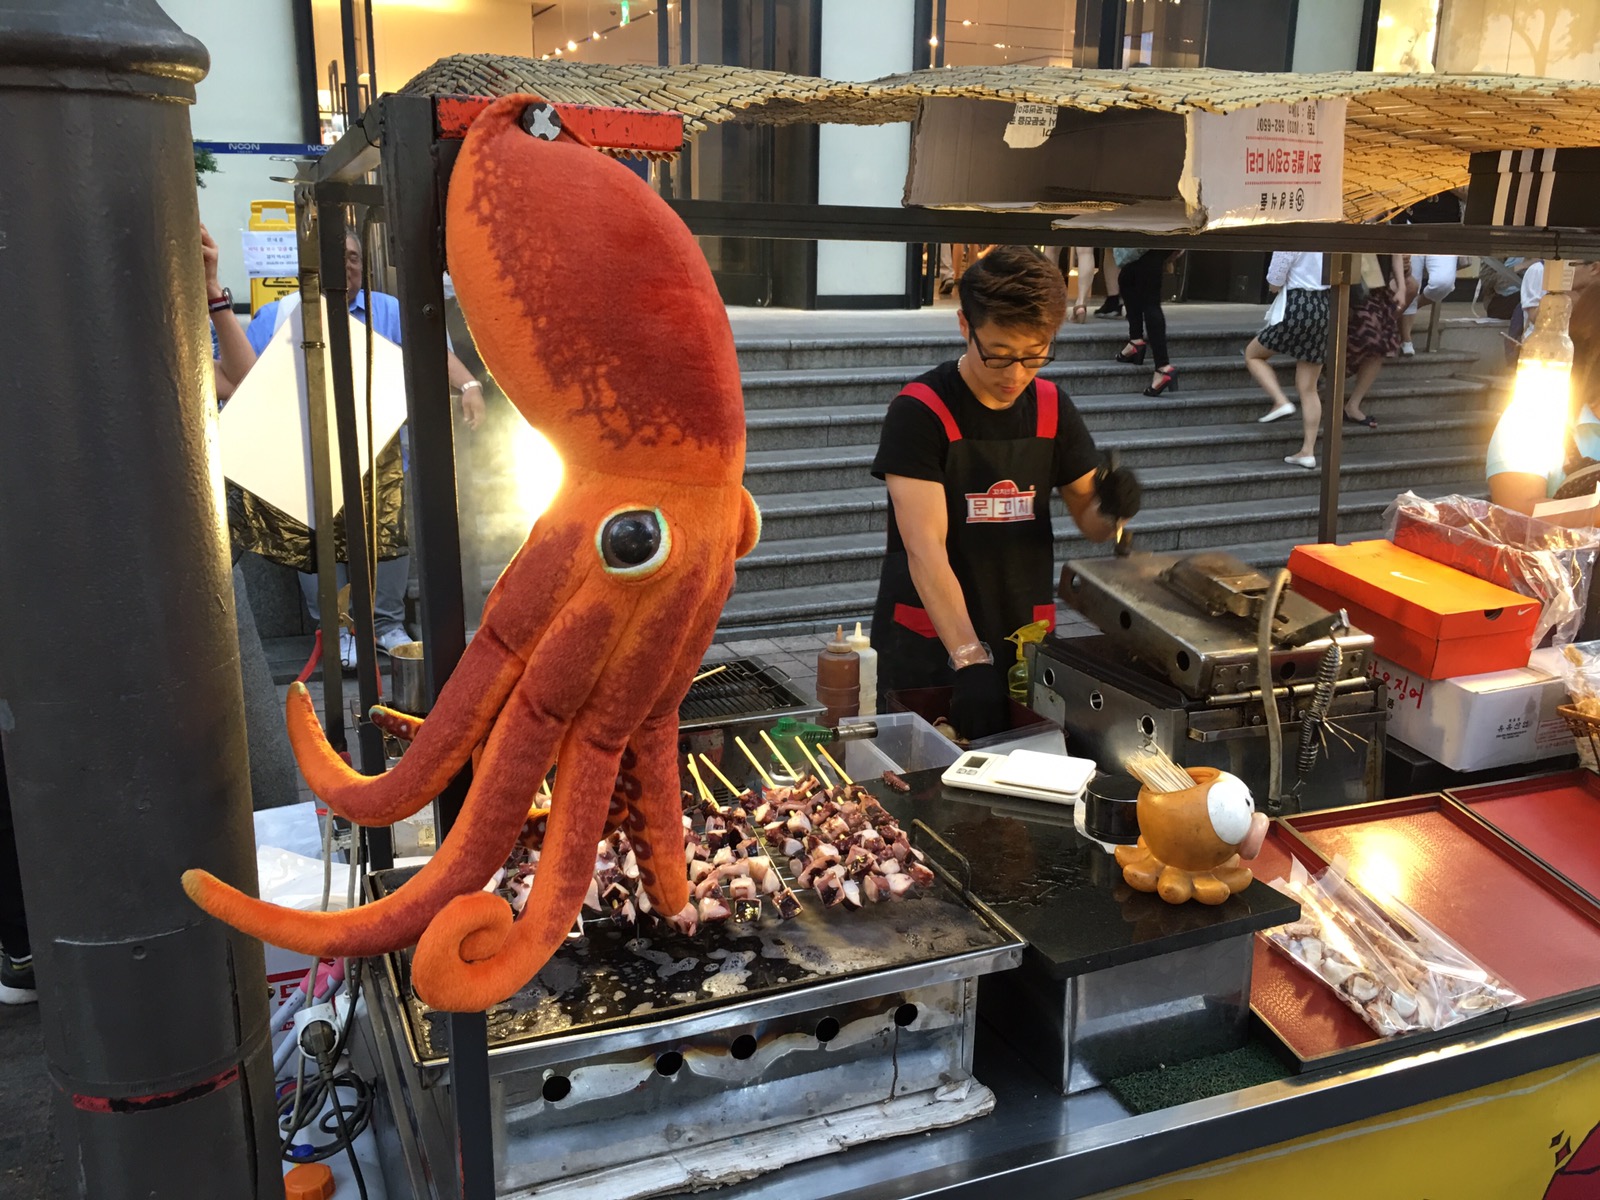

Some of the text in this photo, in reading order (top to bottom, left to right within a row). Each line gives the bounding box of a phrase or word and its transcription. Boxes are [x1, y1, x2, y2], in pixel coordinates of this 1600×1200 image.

[1018, 117, 1046, 126] 주문진읍
[1307, 122, 1315, 135] TEL
[228, 143, 260, 151] NOON
[1246, 148, 1264, 174] 다리
[1266, 148, 1291, 174] 오징어
[1306, 150, 1322, 175] 조미
[972, 498, 1030, 517] 문꼬치
